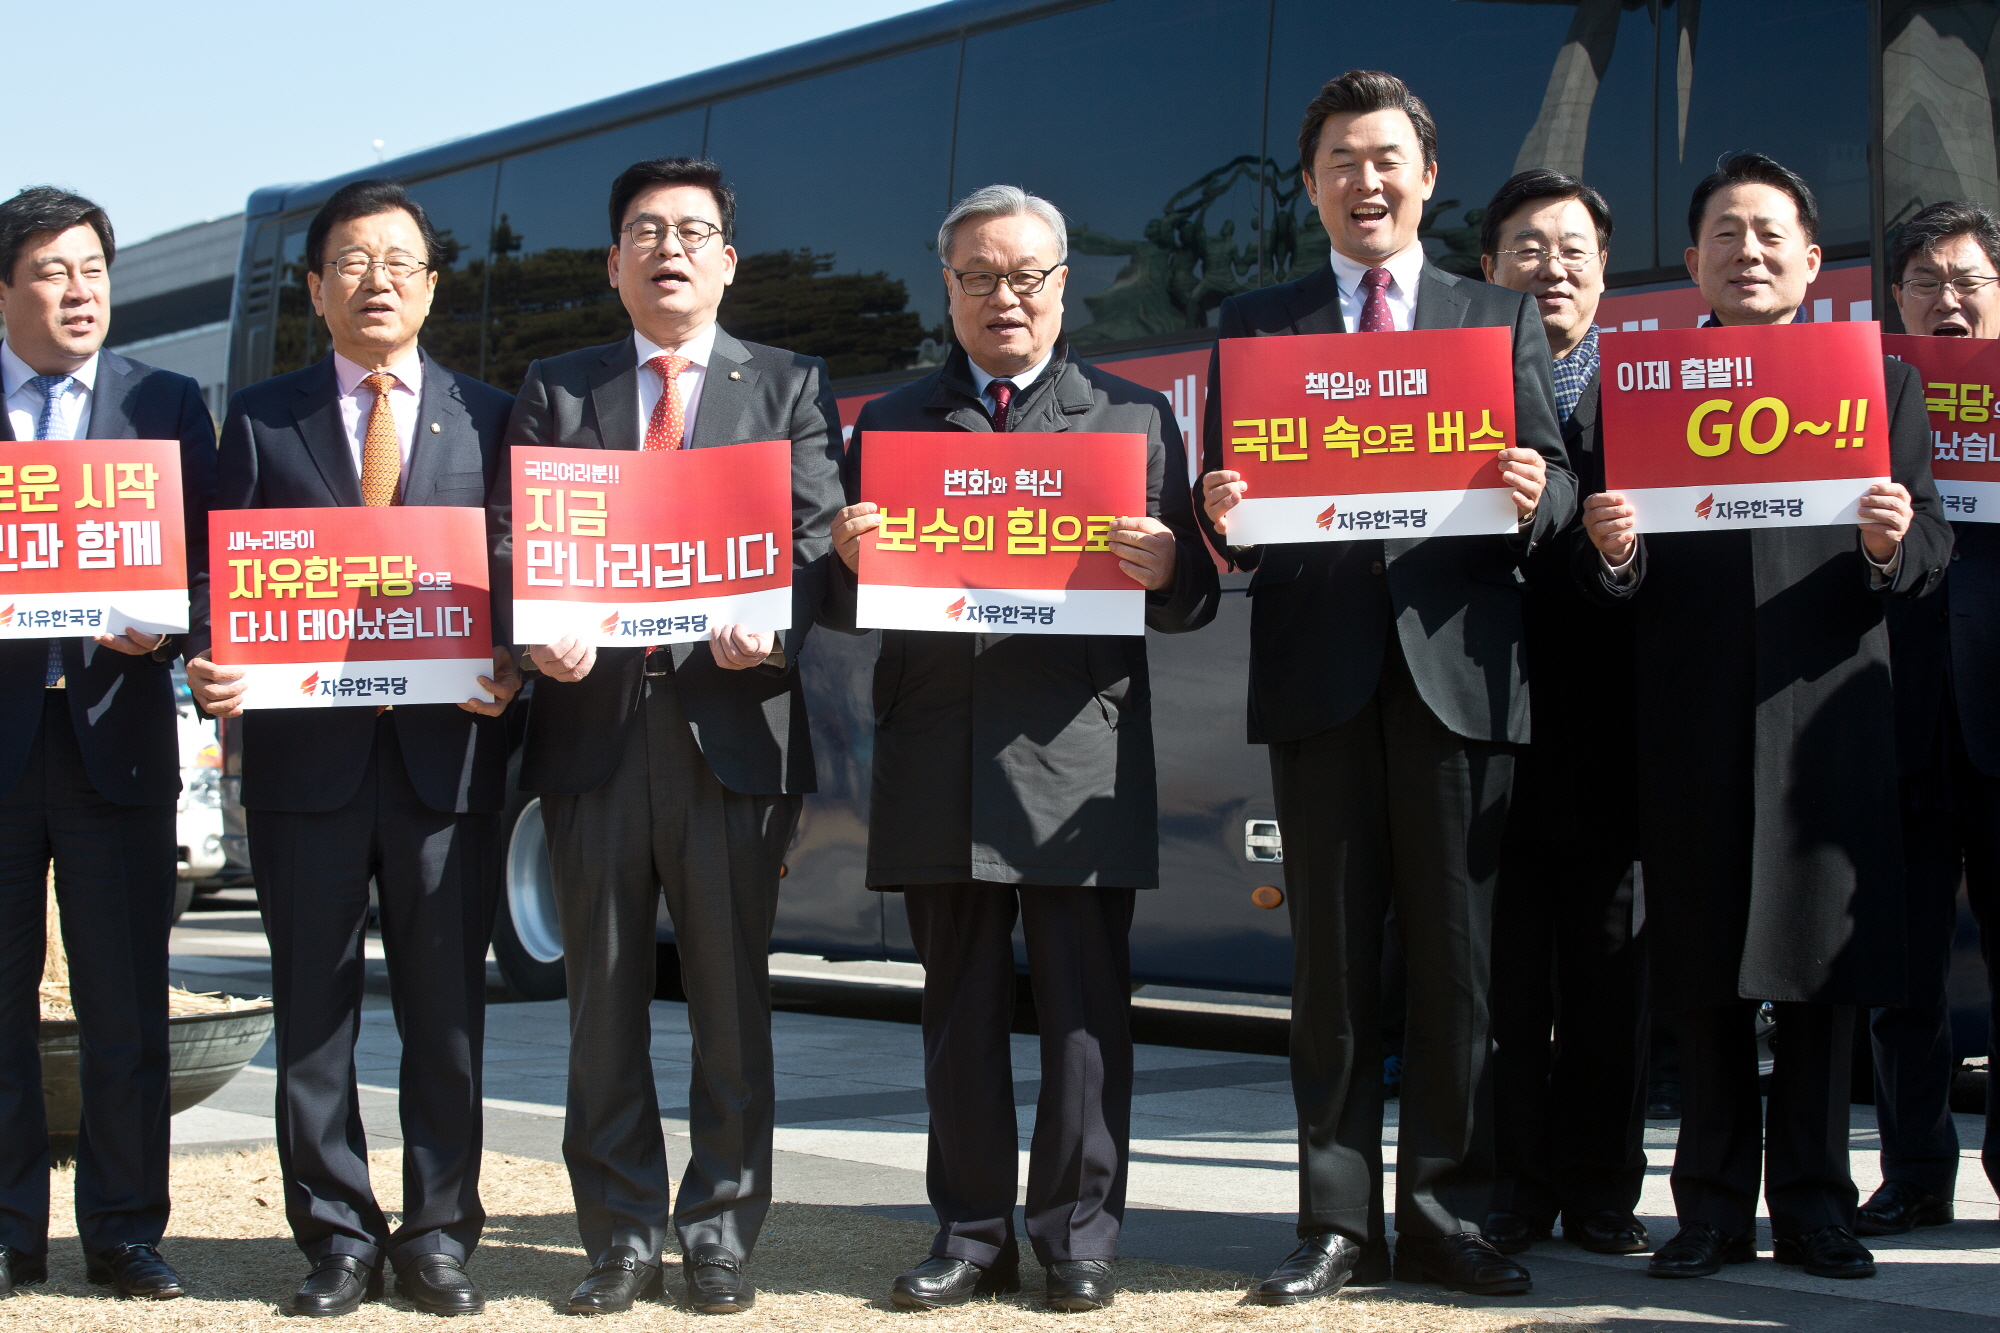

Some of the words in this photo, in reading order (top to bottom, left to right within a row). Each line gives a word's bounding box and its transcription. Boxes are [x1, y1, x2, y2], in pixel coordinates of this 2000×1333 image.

[1305, 371, 1371, 400] 책임와
[1378, 368, 1428, 397] 미래
[1616, 360, 1671, 392] 이제
[1679, 355, 1753, 391] 출발!!
[1230, 417, 1309, 462] 국민
[1322, 415, 1415, 458] 속으로
[1427, 409, 1506, 454] 버스
[74, 462, 160, 510] 시작
[524, 460, 620, 484] 국민여러분!!
[943, 467, 1008, 496] 변화와
[1014, 467, 1063, 498] 혁신
[525, 487, 609, 538] 지금
[1336, 508, 1428, 531] 자유한국당
[1715, 497, 1804, 520] 자유한국당
[1941, 495, 1978, 514] 국당
[76, 519, 163, 570] 함께
[227, 528, 316, 551] 새누리당이
[875, 506, 995, 553] 보수의
[526, 531, 780, 589] 만나러갑니다
[228, 554, 453, 600] 자유한국당으로
[17, 608, 103, 628] 자유한국당
[229, 609, 289, 644] 다시
[297, 605, 473, 643] 태어났습니다
[620, 613, 709, 638] 자유한국당
[965, 604, 1056, 625] 자유한국당
[320, 676, 408, 698] 자유한국당
